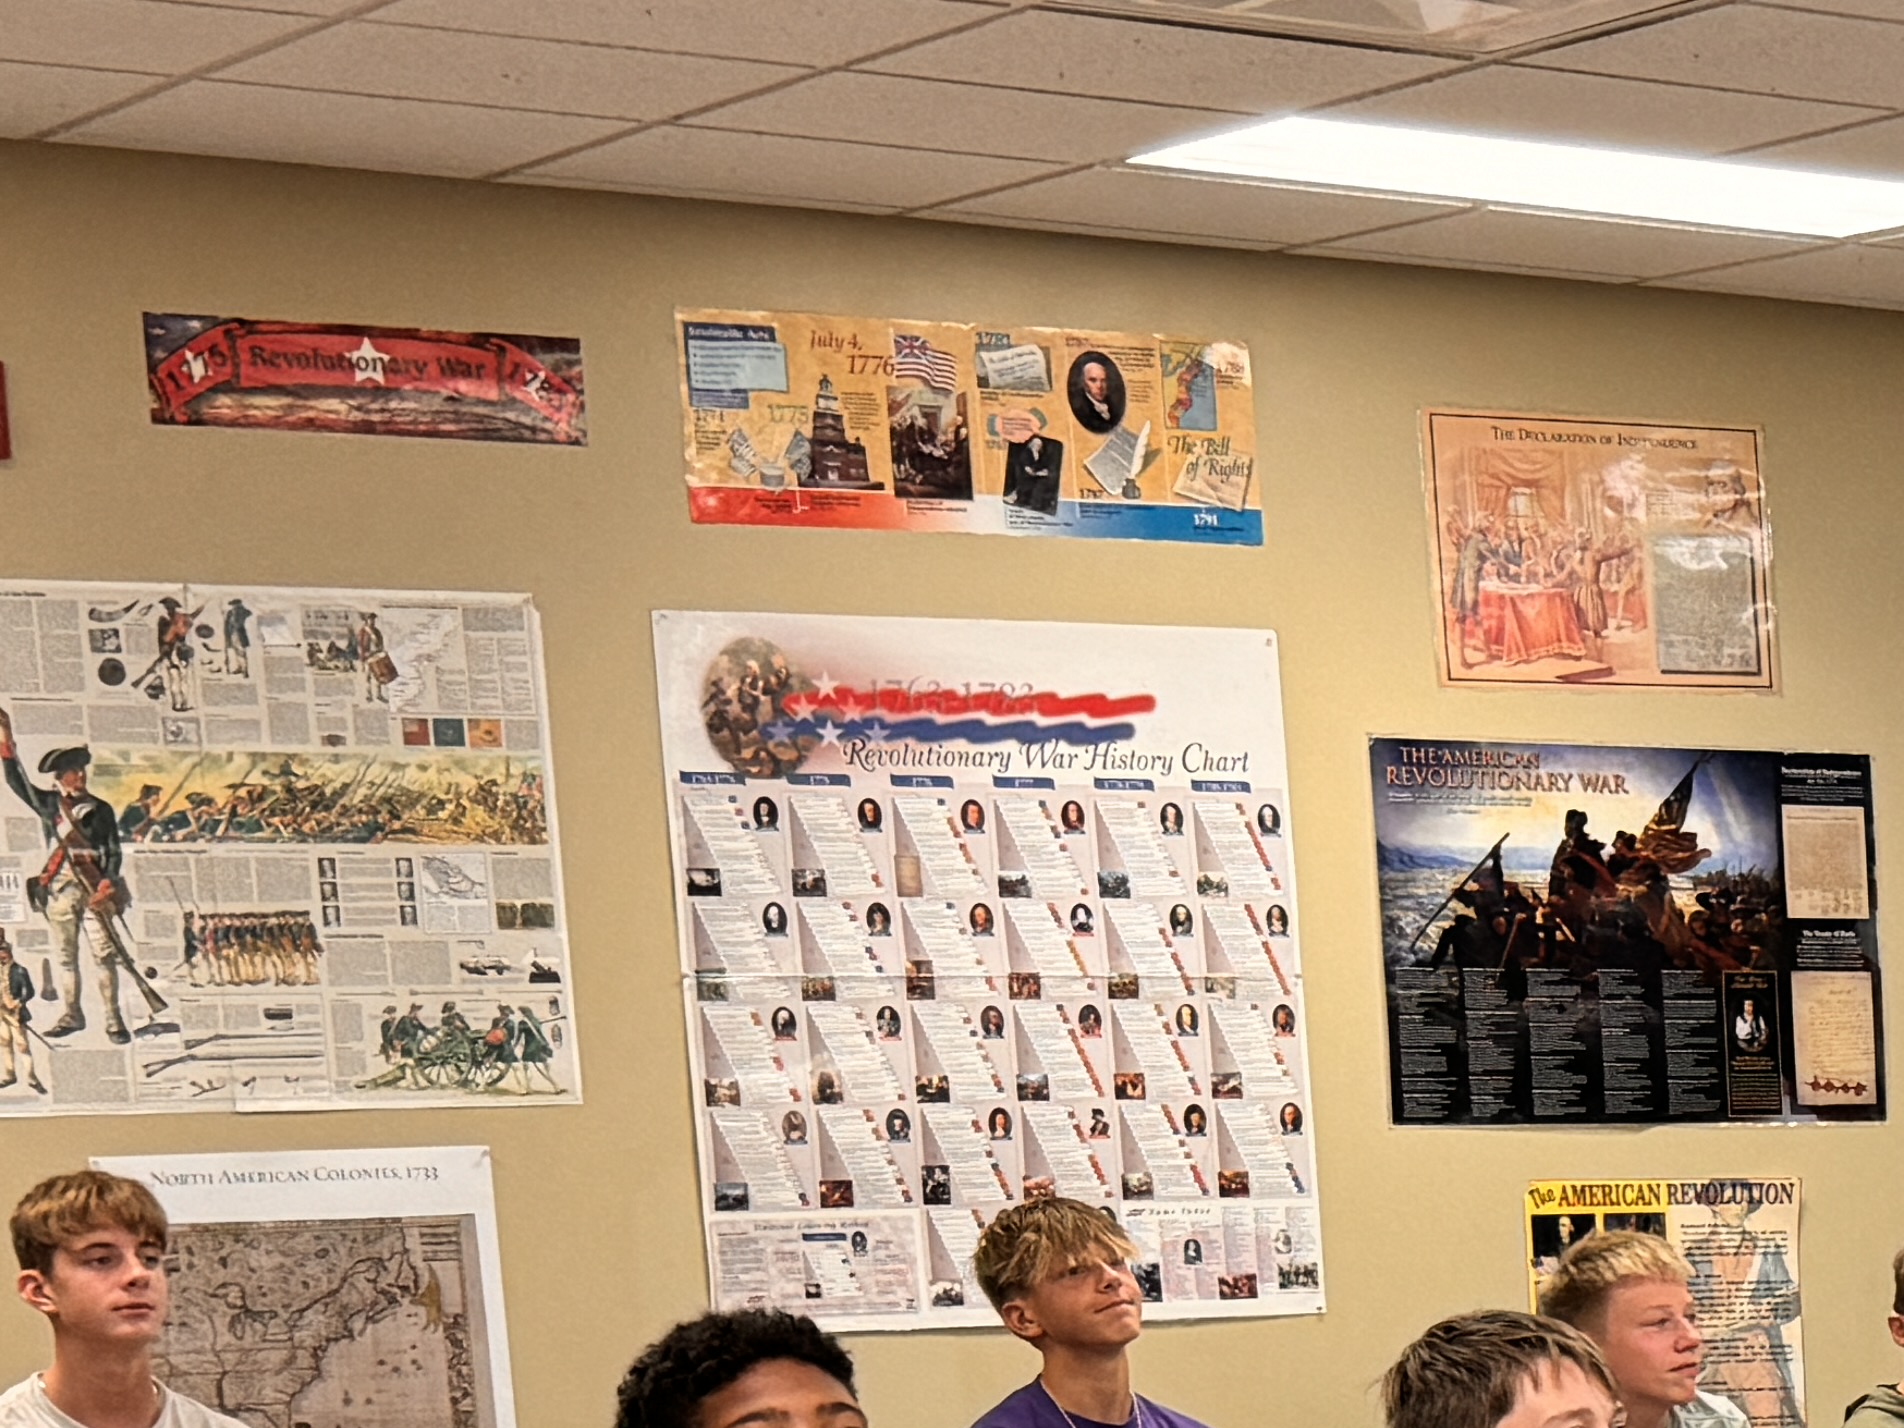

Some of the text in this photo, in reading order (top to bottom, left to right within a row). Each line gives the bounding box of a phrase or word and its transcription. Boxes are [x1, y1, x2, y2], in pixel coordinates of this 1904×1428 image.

[810, 330, 845, 352] July
[248, 345, 430, 382] Revolutionary
[440, 357, 487, 380] War
[847, 354, 895, 377] 1776
[1168, 436, 1231, 457] The Bill
[1186, 457, 1253, 483] of Rights
[842, 737, 1251, 776] Revolutionary War History Chart
[1400, 747, 1540, 770] THE AMERICAN
[1386, 766, 1630, 795] REVOLUTIONARY WAR
[149, 1171, 213, 1187] NORTH
[218, 1169, 309, 1185] AMERICAN
[406, 1167, 439, 1181] 1733
[1528, 1182, 1796, 1210] The AMERICAN REVOLUTION
